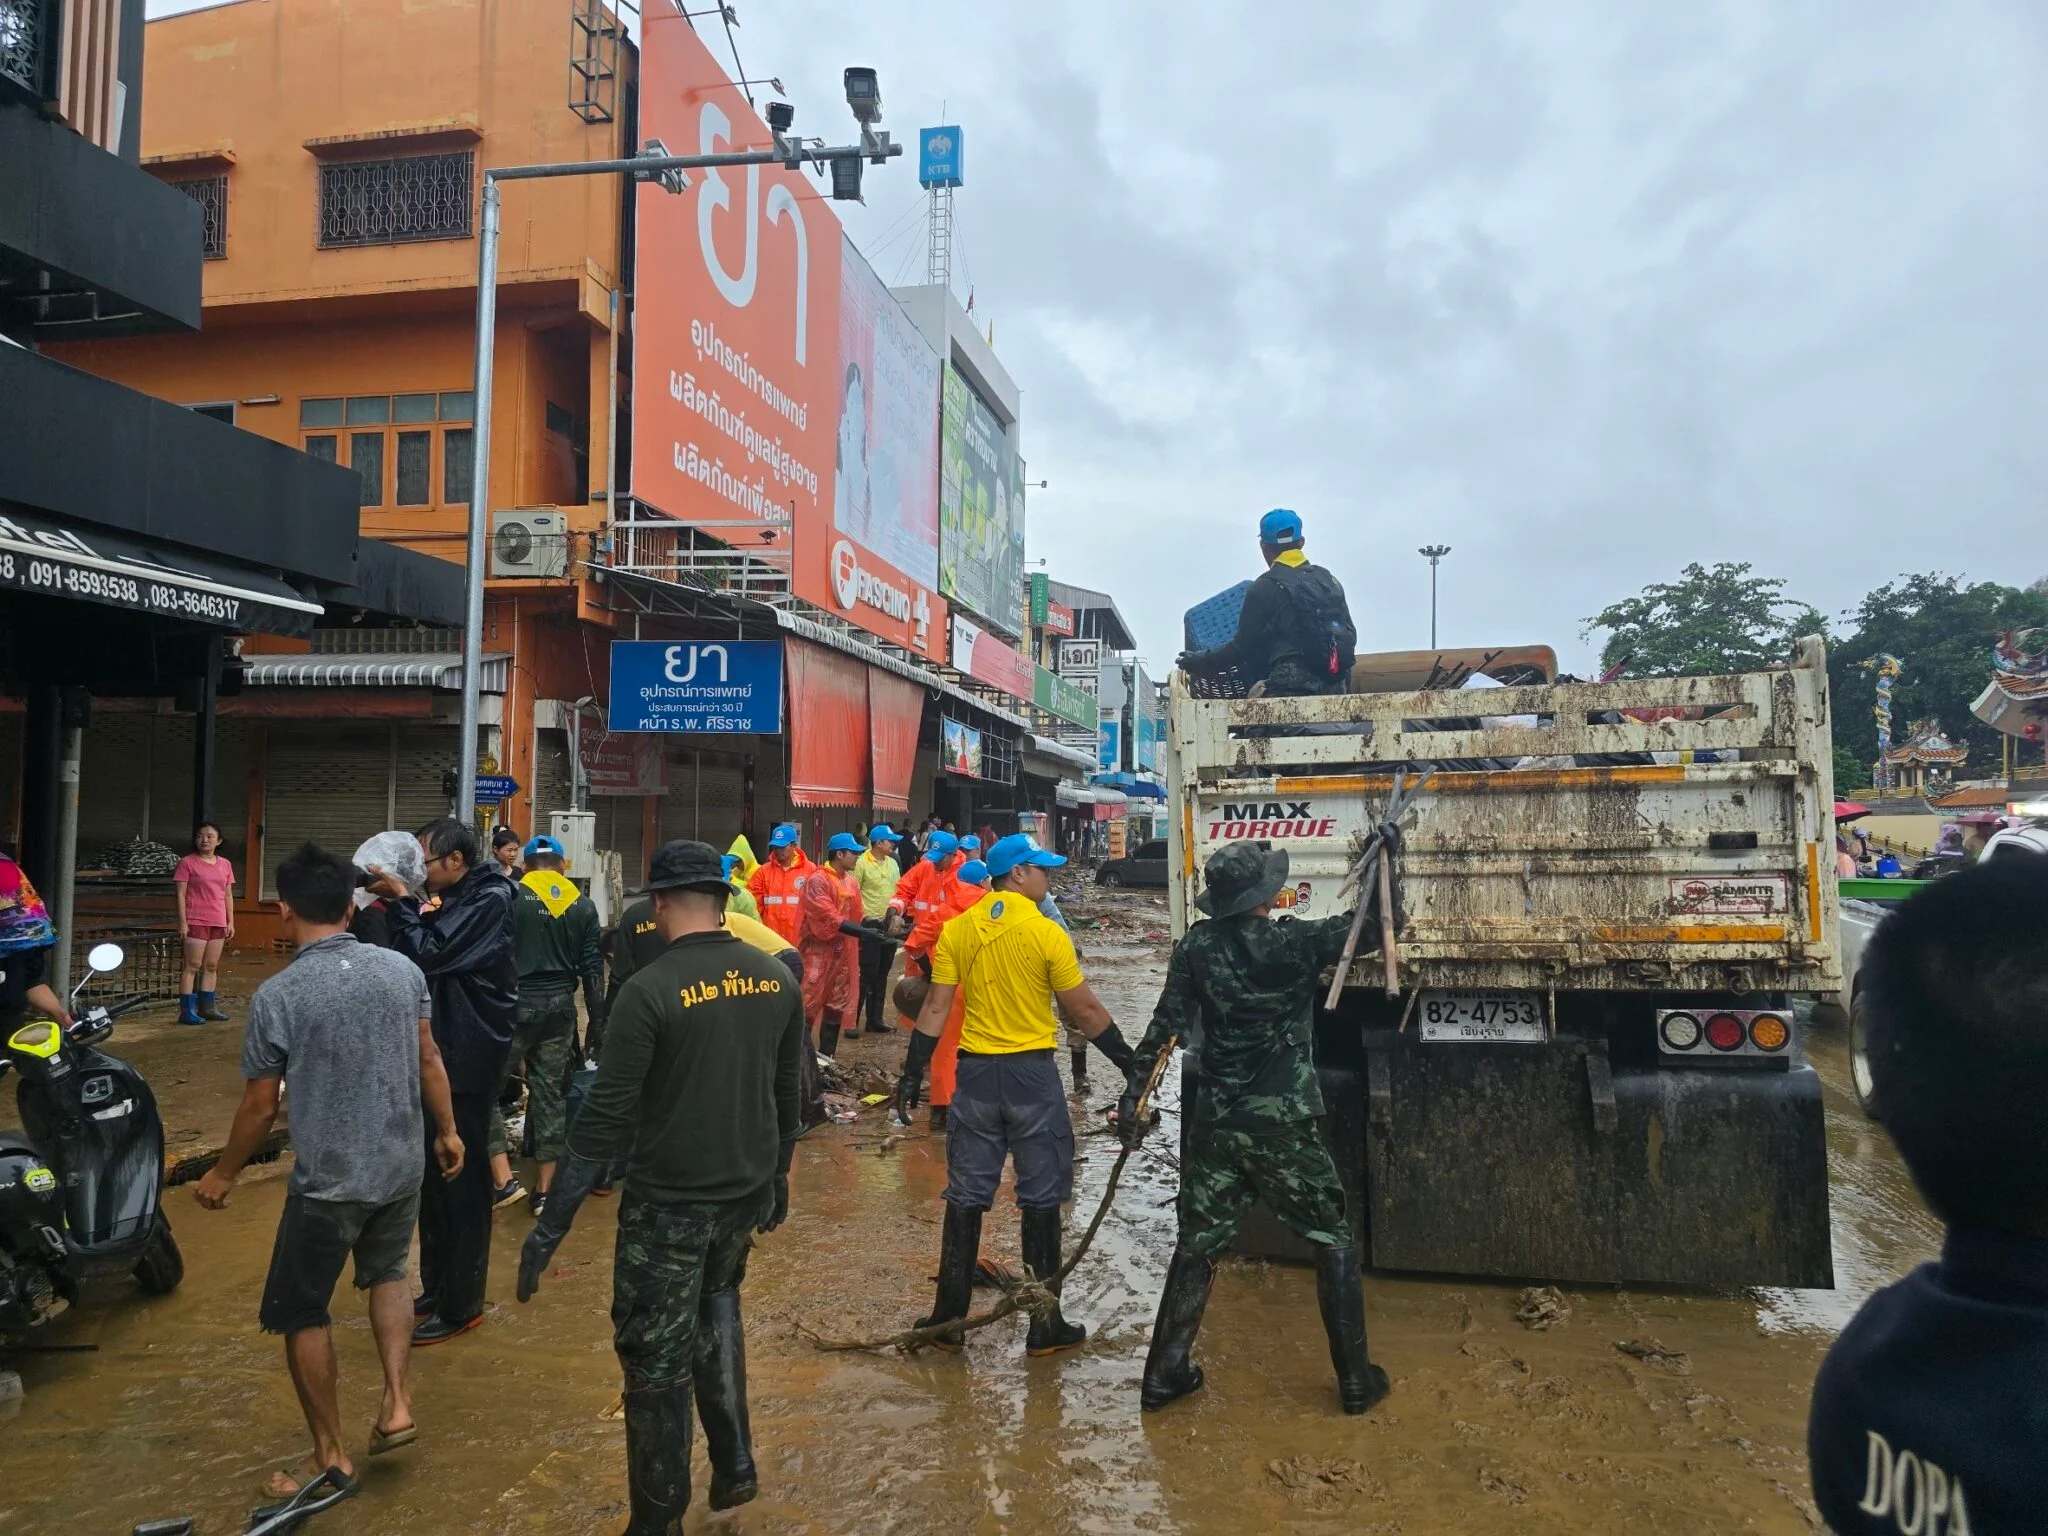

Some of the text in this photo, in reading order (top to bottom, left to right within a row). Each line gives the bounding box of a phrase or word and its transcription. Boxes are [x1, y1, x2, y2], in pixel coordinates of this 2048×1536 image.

[928, 164, 950, 176] KTB
[697, 102, 808, 368] ยา
[691, 319, 807, 431] อุปกรณ์การแพทย์
[670, 369, 818, 506] ผลิตภัณฑ์ดูแลผู้สูงอายุ
[857, 567, 911, 624] FASCINO
[664, 644, 728, 683] ยา
[1065, 648, 1094, 665] เอก
[640, 684, 752, 701] อุปกรณ์การแพทย์
[648, 702, 744, 712] ประสบการณ์กว่า 30 ปี
[639, 714, 752, 730] หน้า ร.พ. ศิริราช
[1223, 801, 1312, 821] MAX
[1208, 818, 1337, 840] TORQUE
[1711, 885, 1774, 896] SAMMITR
[680, 969, 780, 1008] ม.๒ พัน.๑๐
[1426, 1001, 1535, 1025] 82-4753
[1460, 1025, 1505, 1036] เชียงราย
[1857, 1430, 1973, 1536] DOPA
